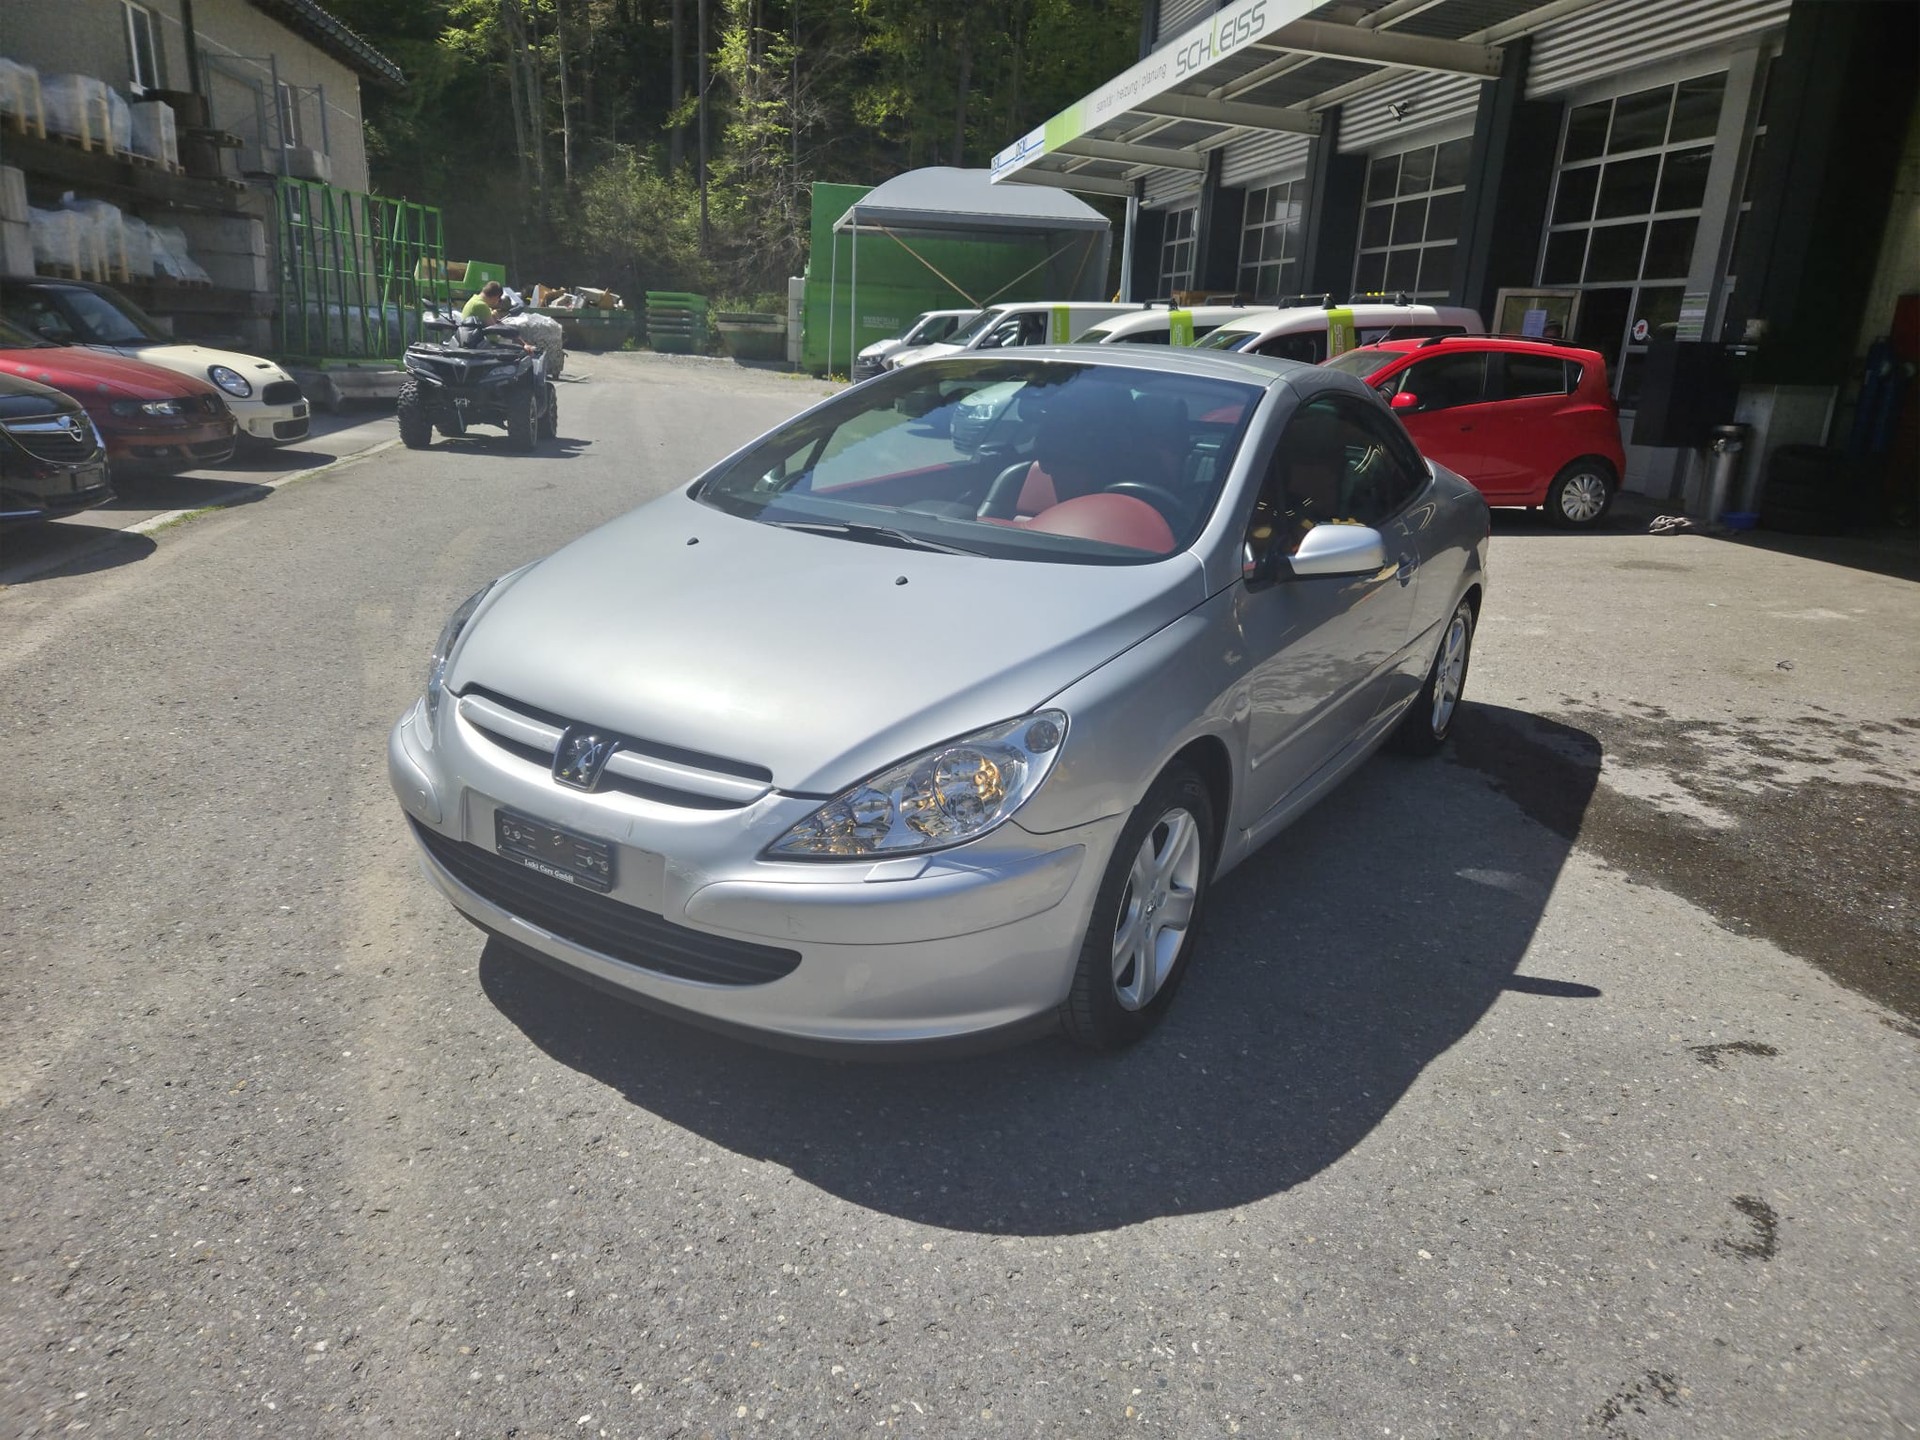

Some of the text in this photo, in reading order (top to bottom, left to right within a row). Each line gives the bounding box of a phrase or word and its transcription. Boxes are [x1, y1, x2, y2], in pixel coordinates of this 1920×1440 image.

[1175, 0, 1267, 78] SCHLEISS
[540, 864, 554, 876] Cars
[554, 869, 574, 883] GmbH
